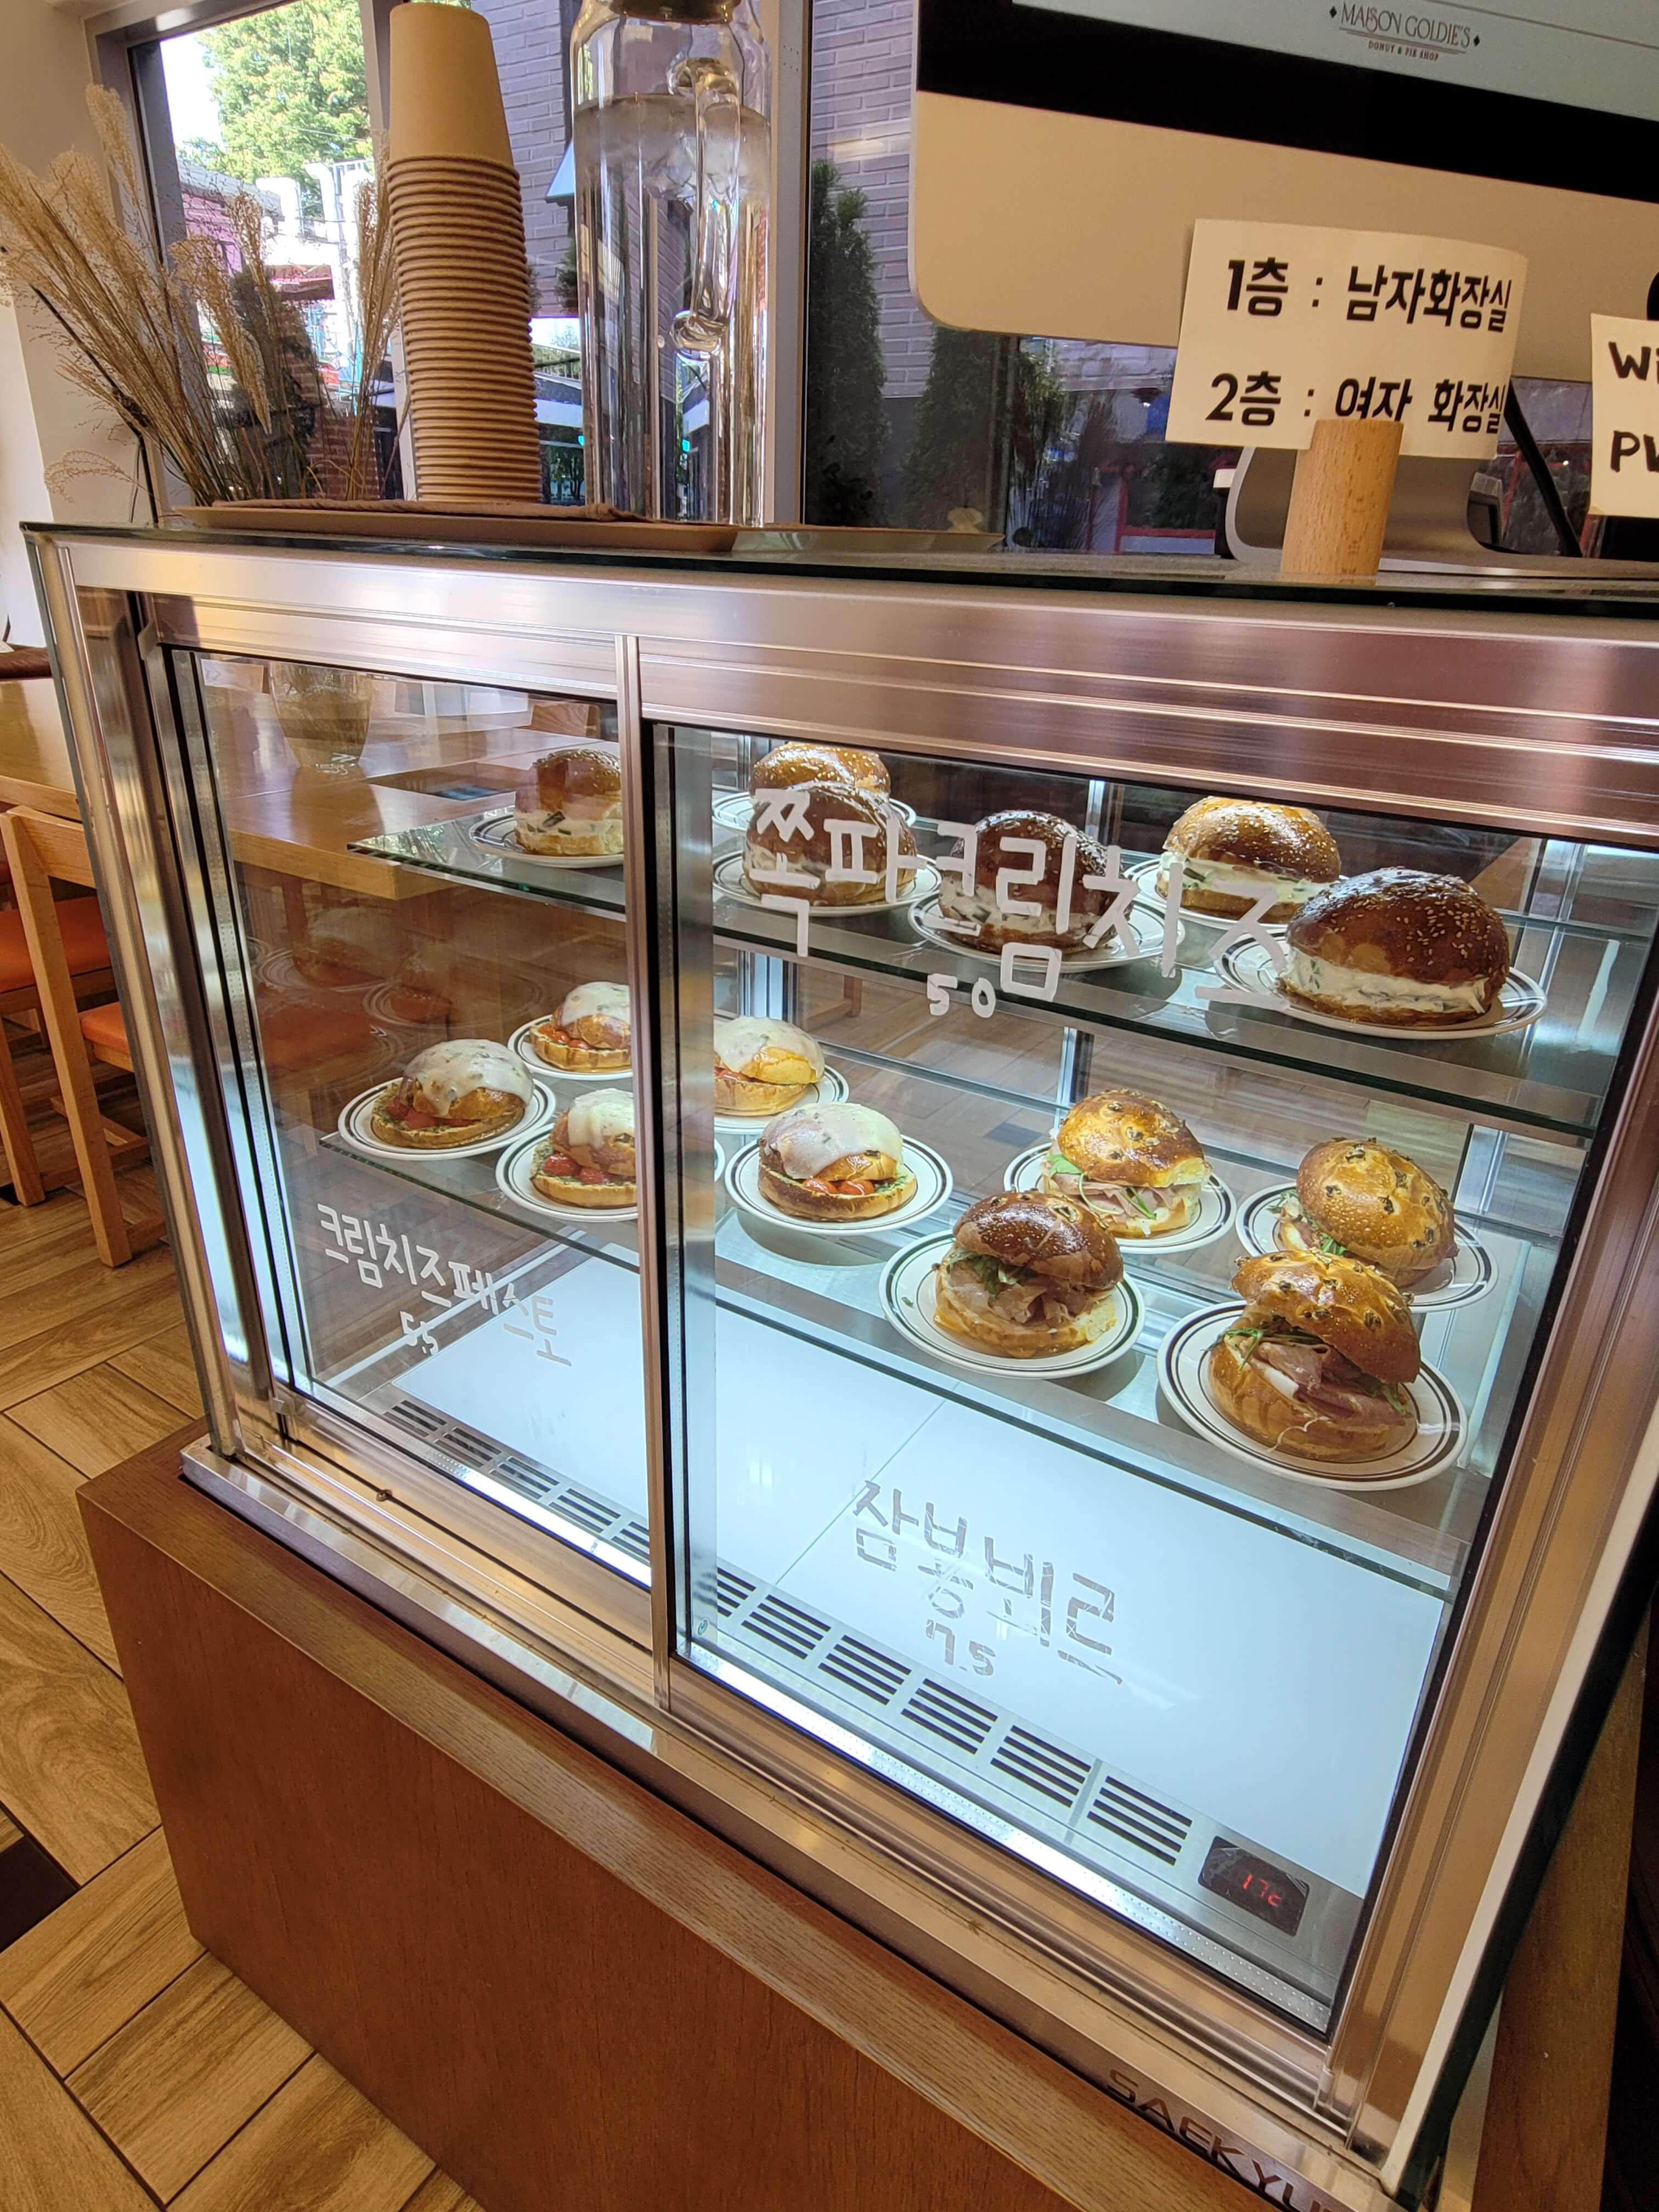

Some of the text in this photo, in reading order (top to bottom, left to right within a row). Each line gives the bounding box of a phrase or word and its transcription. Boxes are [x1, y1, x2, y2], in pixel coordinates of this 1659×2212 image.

[1341, 3, 1402, 34] MAISON
[1368, 41, 1395, 53] DONUT
[1227, 257, 1289, 317] 1층
[1346, 264, 1512, 333] 남자화장실
[1205, 370, 1282, 426] 2층
[1335, 376, 1413, 422] 여자
[1427, 379, 1506, 434] 화장실
[926, 1618, 997, 1677] 7.5
[1107, 2069, 1334, 2212] SAEKYU
